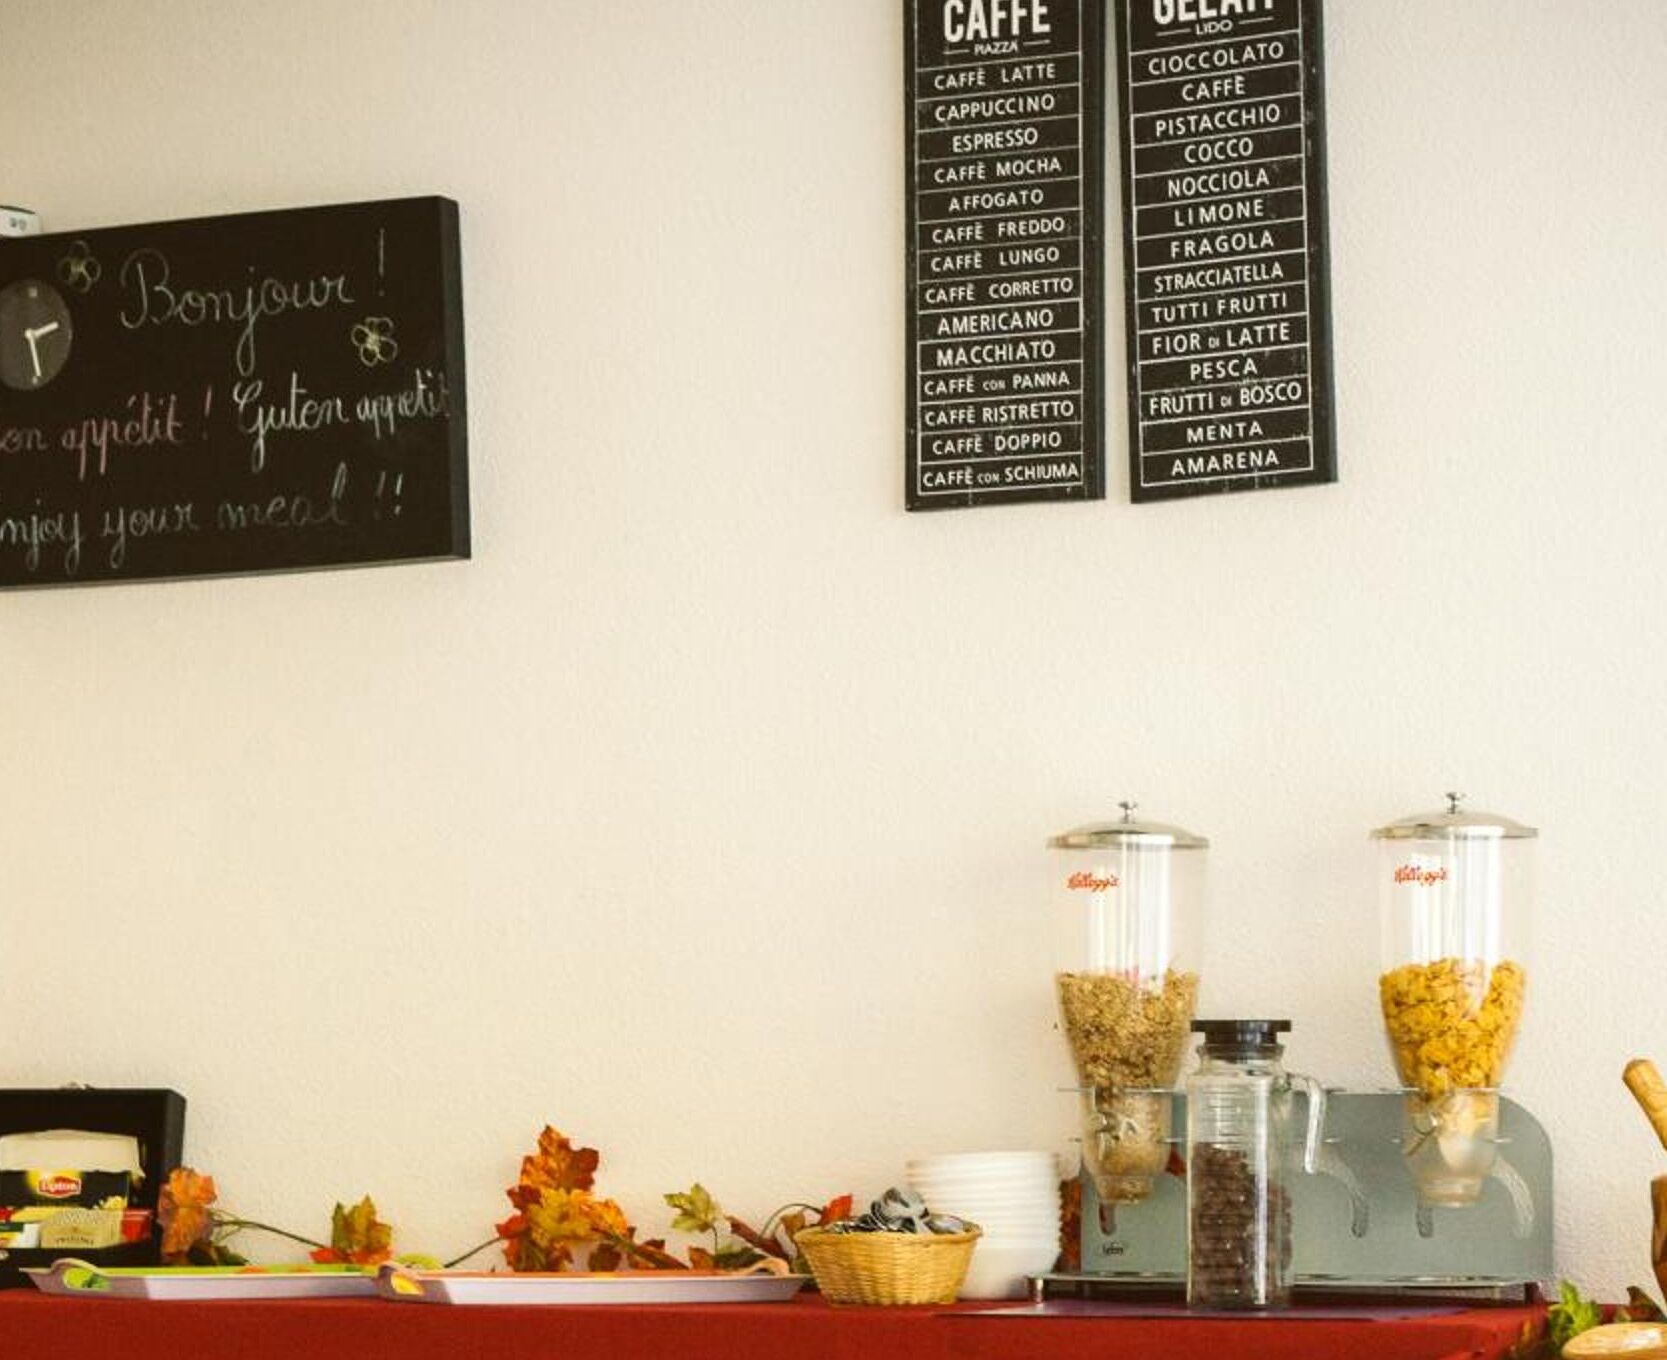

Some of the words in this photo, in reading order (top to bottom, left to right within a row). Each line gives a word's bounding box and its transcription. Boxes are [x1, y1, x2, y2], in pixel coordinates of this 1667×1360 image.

[1153, 0, 1274, 24] GEL
[1195, 20, 1233, 35] LIDO
[974, 41, 1018, 55] PIAZZA
[1148, 41, 1285, 75] CIOCCOLATO
[934, 68, 986, 91] CAFFÈ
[1001, 64, 1056, 83] LATTE
[1181, 75, 1246, 101] CAFFÈ
[935, 94, 1055, 122] CAPPUCCINO
[1155, 104, 1281, 137] PISTACCHIO
[952, 128, 1038, 152] ESPRESSO
[1184, 138, 1254, 164] COCCO
[934, 161, 986, 183] CAFFÈ
[996, 157, 1062, 177] MOCHA
[1167, 167, 1270, 198] NOCCIOLA
[948, 189, 1045, 212] AFFOGATO
[1174, 199, 1264, 227] LIMONE
[932, 222, 984, 244] CAFFÈ
[998, 217, 1065, 237] FREDDO
[1170, 230, 1275, 259] FRAGOLA
[931, 250, 982, 272] CAFFÈ
[999, 247, 1060, 267] LUNGO
[925, 282, 975, 304] CAFFÈ
[988, 277, 1074, 300] CORRETTO
[1153, 262, 1284, 292] STRACCIATELLA
[120, 248, 355, 377] Bonjour
[1152, 298, 1208, 322] TUTTI
[1217, 292, 1287, 315] FRUTTI
[937, 309, 1054, 336] AMERICANO
[1152, 333, 1200, 355] FIOR
[1208, 336, 1221, 349] DI
[1226, 322, 1290, 346] LATTE
[936, 340, 1056, 367] MACCHIATO
[1189, 359, 1258, 380] PESCA
[924, 374, 976, 396] CAFFÈ
[982, 379, 1006, 391] CON
[1012, 371, 1070, 389] PANNA
[1149, 390, 1215, 415] FRUTTI
[1220, 394, 1233, 407] DI
[1240, 381, 1301, 406] BOSCO
[924, 406, 976, 427] CAFFÈ
[982, 401, 1074, 422] RISTRETTO
[0, 427, 48, 453] on
[61, 391, 183, 482] appétit
[932, 435, 983, 455] CAFFÈ
[994, 431, 1061, 451] DOPPIO
[1186, 421, 1264, 443] MENTA
[922, 466, 975, 487] CAFFÈ
[977, 471, 1000, 484] CON
[1004, 462, 1080, 482] SCHIUMA
[1171, 450, 1280, 477] AMARENA
[0, 498, 84, 577] njoy
[102, 502, 199, 570] your
[216, 461, 348, 529] meal
